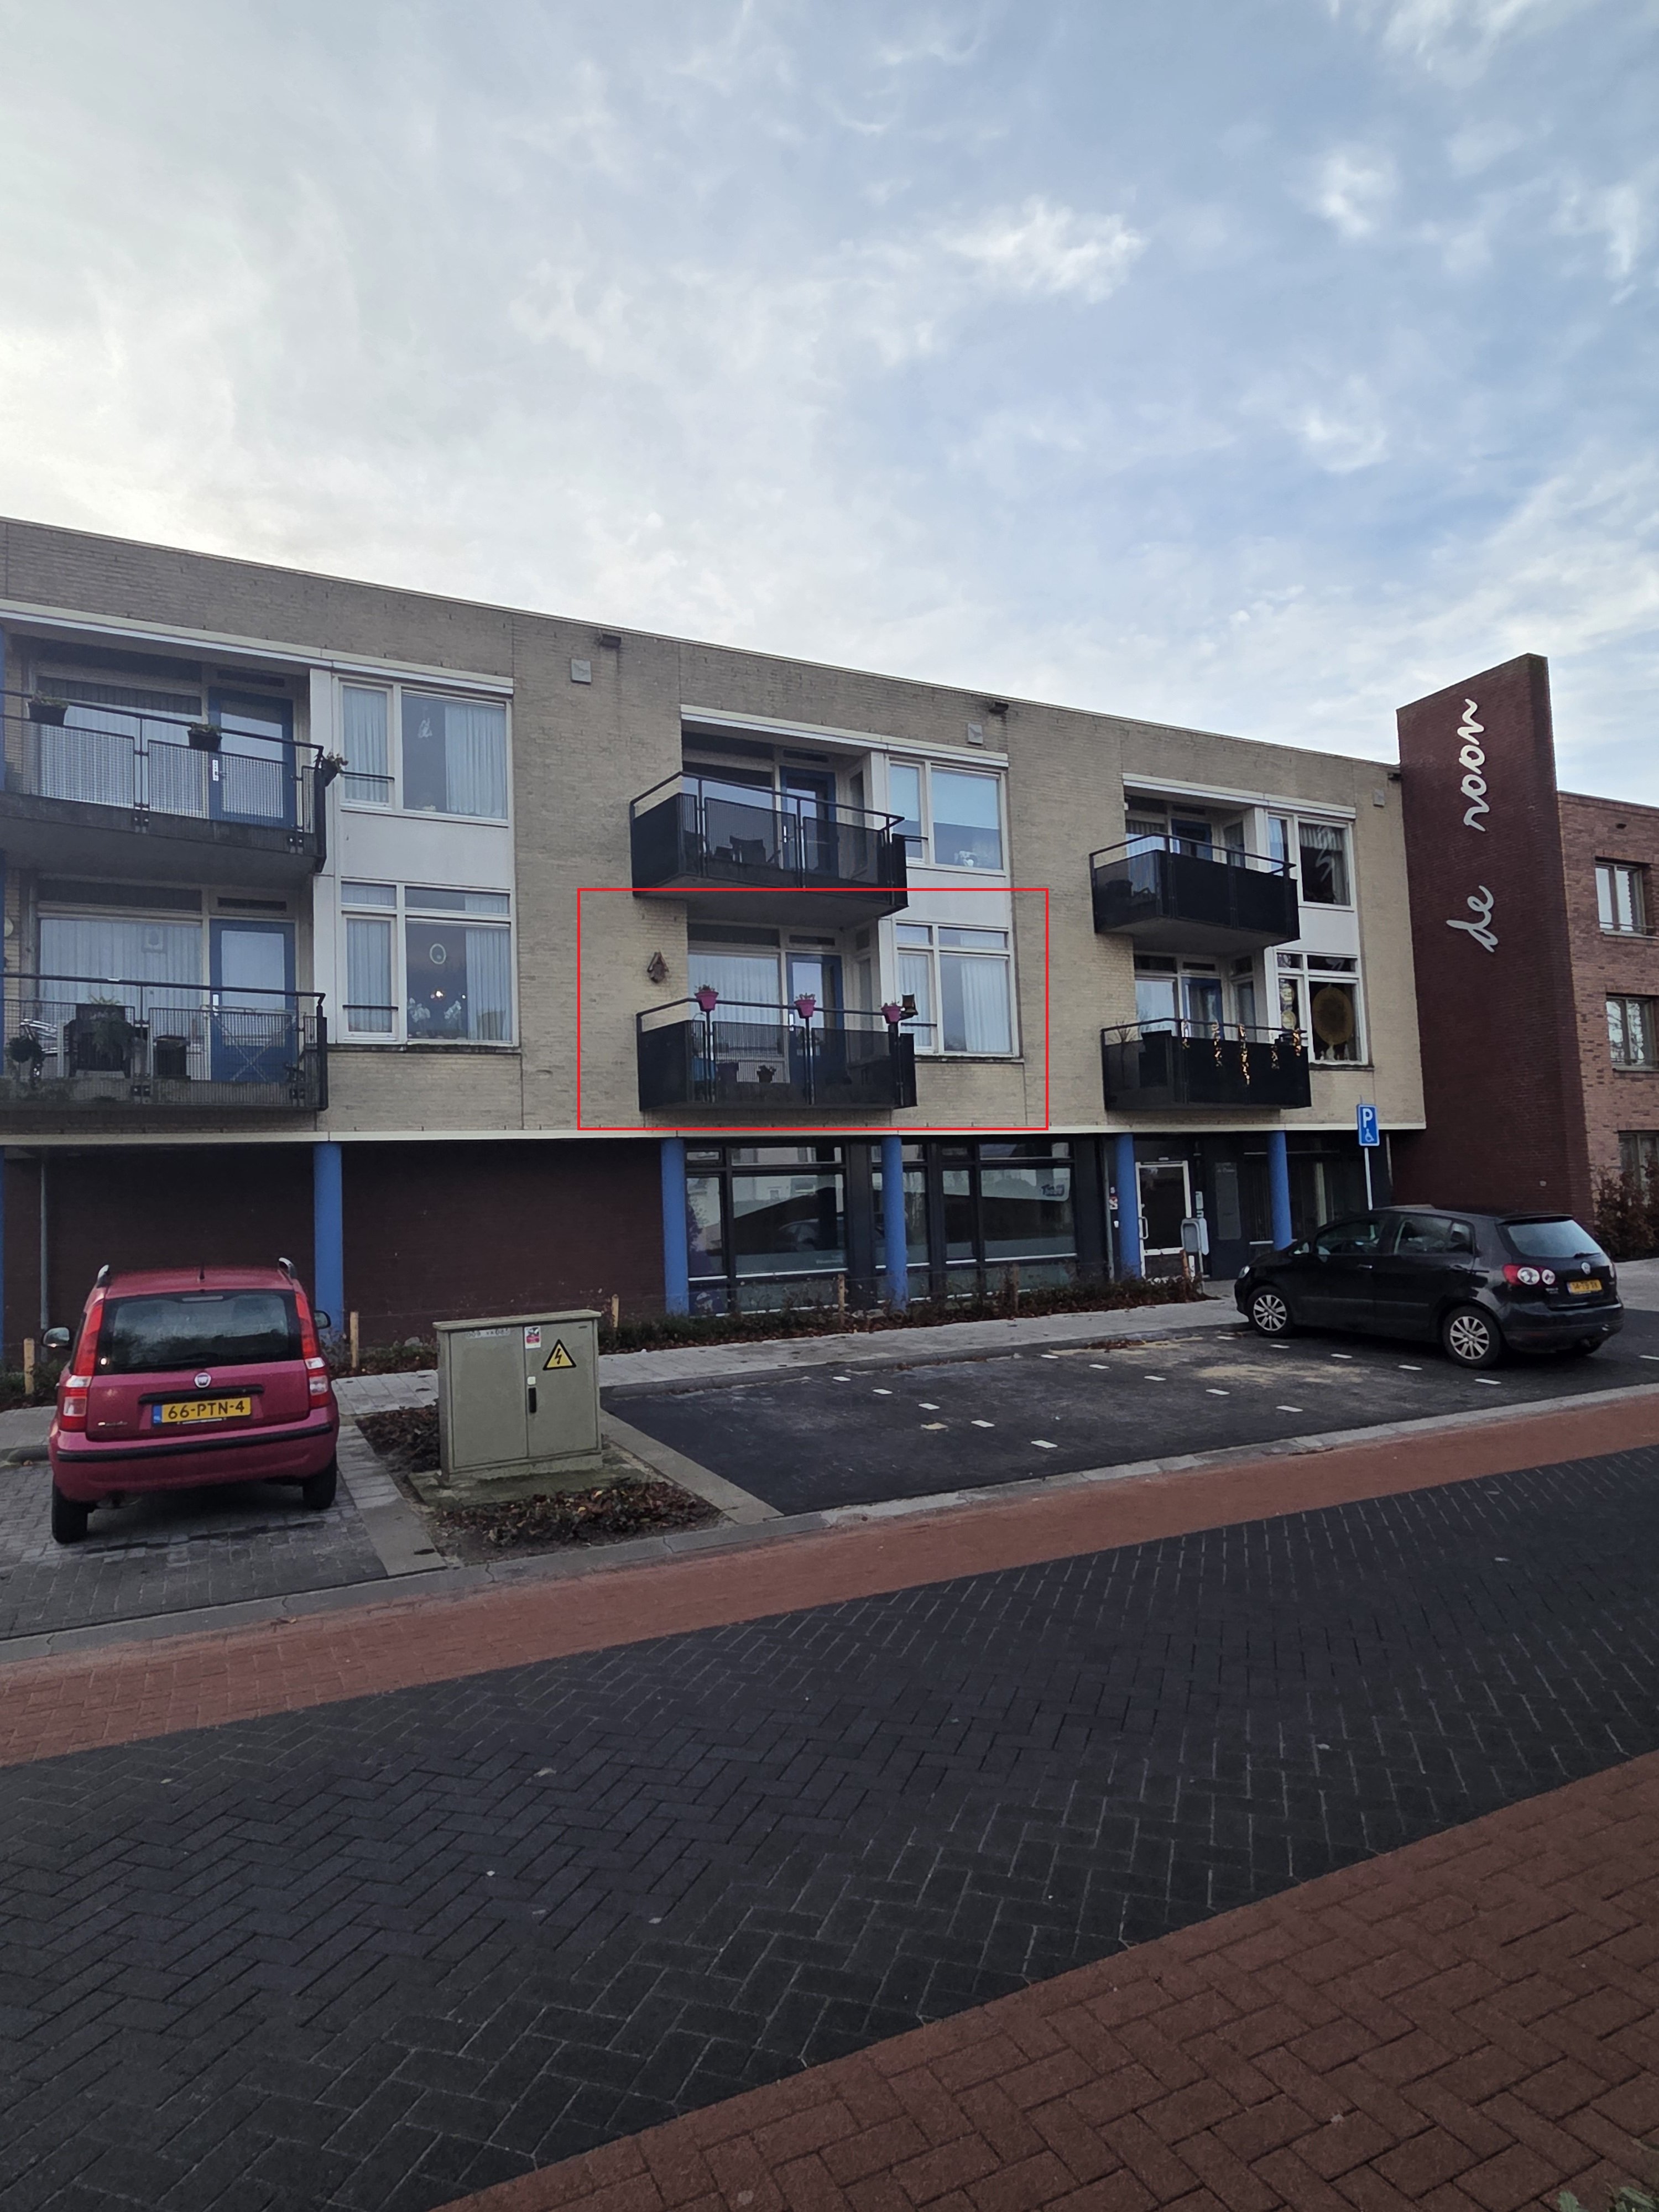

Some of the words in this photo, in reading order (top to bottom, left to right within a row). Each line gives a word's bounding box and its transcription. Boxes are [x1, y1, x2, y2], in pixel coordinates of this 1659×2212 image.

[1446, 885, 1499, 953] de
[1363, 1108, 1373, 1128] P
[168, 1400, 245, 1420] 66-PTN-4
